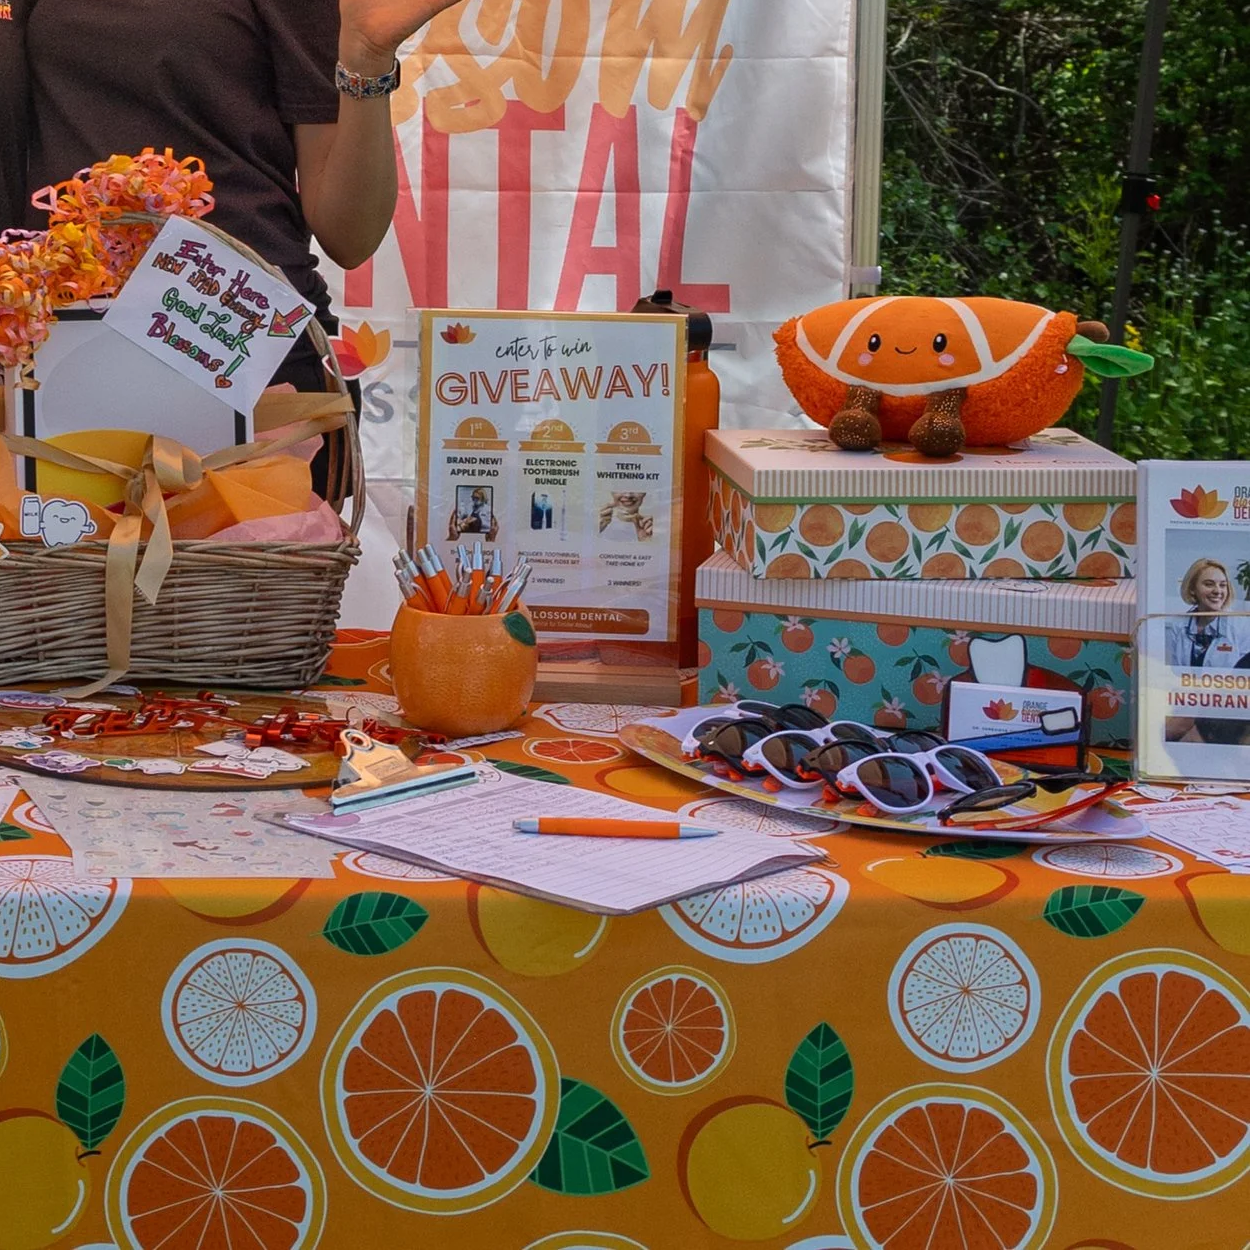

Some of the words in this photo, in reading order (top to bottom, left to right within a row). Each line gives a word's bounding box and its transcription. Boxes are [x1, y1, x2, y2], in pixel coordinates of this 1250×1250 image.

[343, 99, 731, 313] NTAL
[152, 252, 187, 276] NEW
[227, 269, 270, 310] Here
[162, 287, 207, 324] Good
[495, 337, 538, 362] enter
[539, 335, 558, 361] to
[561, 338, 593, 358] win
[435, 363, 670, 406] GIVEAWAY!
[469, 422, 483, 437] 1st
[542, 425, 563, 439] 2nd
[620, 427, 639, 440] 3rd
[446, 456, 477, 465] BRAND
[479, 457, 503, 466] NEW!
[526, 458, 577, 468] ELECTRONIC
[615, 462, 641, 471] TEETH
[450, 468, 476, 477] APPLE
[477, 468, 499, 477] IPAD
[523, 468, 580, 477] TOOTHBRUSH
[596, 471, 645, 480] WHITENING
[646, 472, 660, 480] KIT
[534, 478, 567, 486] BUNDLE
[580, 613, 623, 622] DENTAL
[1181, 673, 1250, 689] BLOSSO
[1168, 692, 1248, 708] INSURAN
[1021, 714, 1040, 723] DENT
